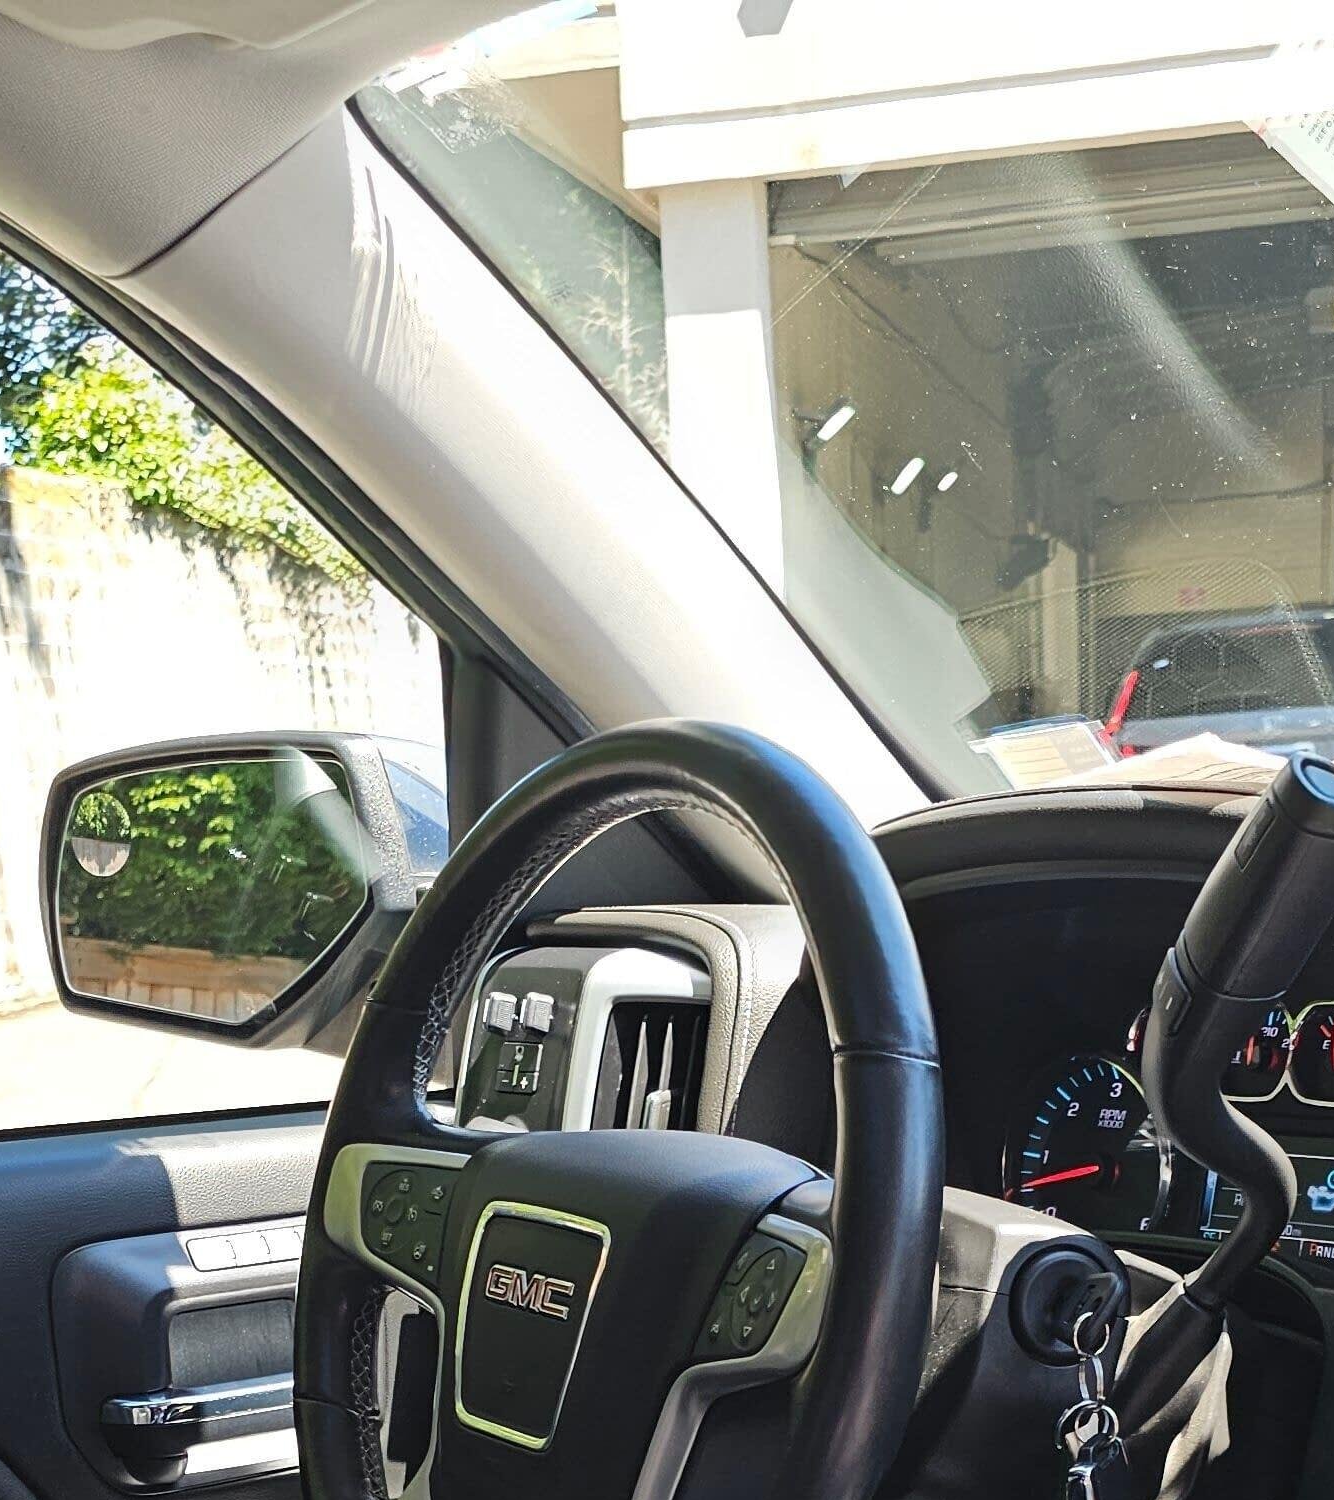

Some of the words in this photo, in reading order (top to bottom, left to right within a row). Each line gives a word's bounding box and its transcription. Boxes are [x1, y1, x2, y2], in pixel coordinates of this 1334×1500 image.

[1322, 1039, 1330, 1050] E
[1109, 1082, 1123, 1098] 3
[1067, 1102, 1080, 1117] 2
[1099, 1108, 1127, 1121] RPM
[1042, 1149, 1050, 1165] 1
[485, 1263, 575, 1320] GMC
